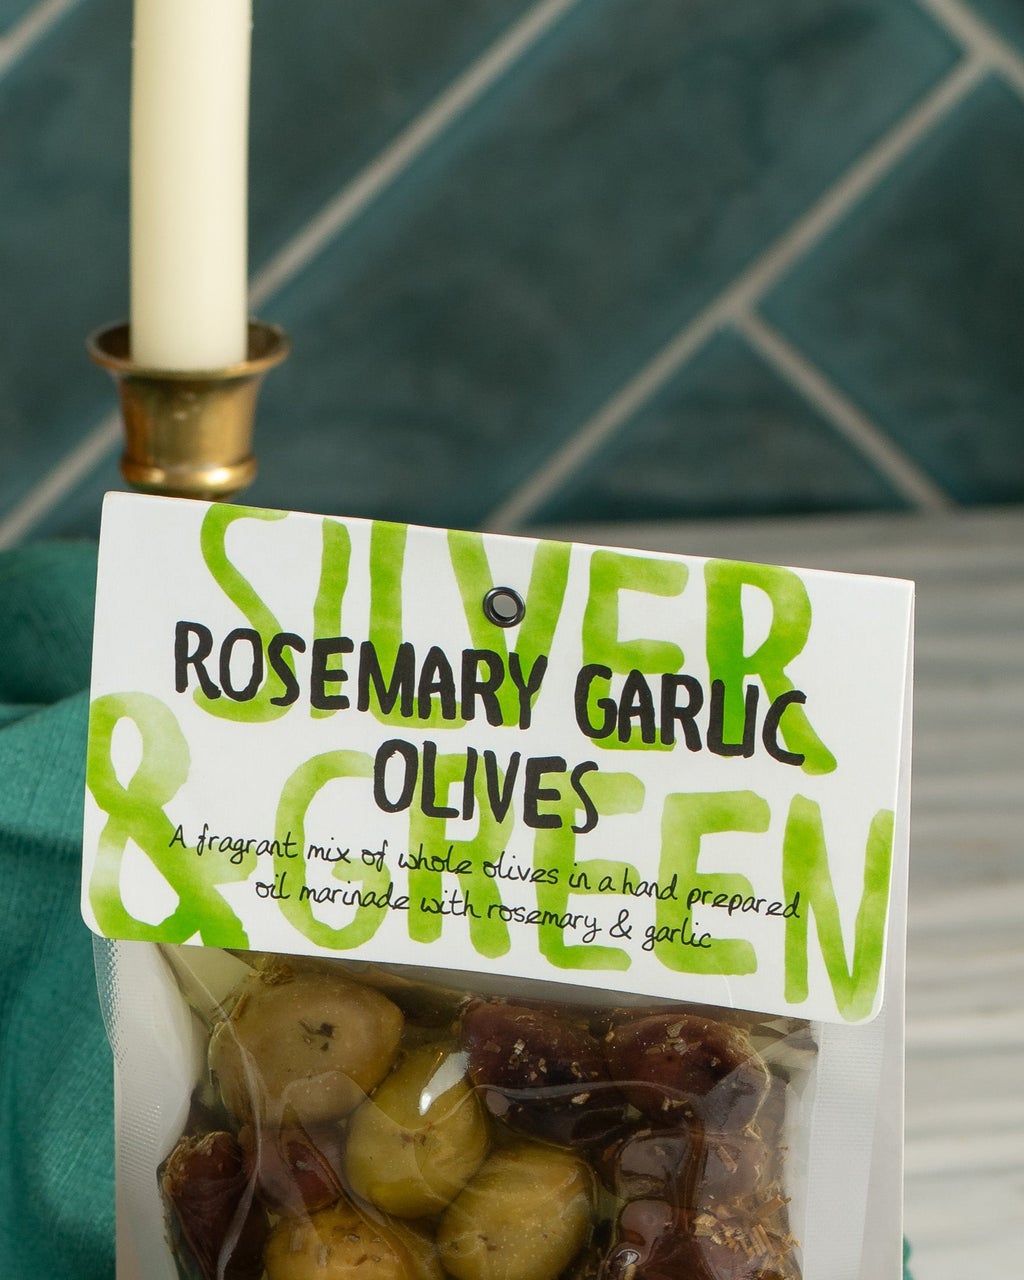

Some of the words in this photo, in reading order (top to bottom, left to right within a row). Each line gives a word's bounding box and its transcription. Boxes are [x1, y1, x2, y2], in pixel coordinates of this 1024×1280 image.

[175, 620, 548, 730] ROSEMARY
[575, 662, 807, 767] GARLIC
[193, 503, 837, 775] SILVER
[374, 738, 599, 833] OLIVES
[169, 823, 186, 848] A
[196, 823, 298, 864] fragrant
[307, 837, 352, 863] mix
[361, 840, 388, 872] of
[398, 843, 473, 874] whole
[483, 851, 559, 885] olives
[569, 863, 591, 889] in
[598, 873, 616, 892] a
[622, 867, 678, 901] hand
[686, 887, 800, 918] prepared
[255, 873, 290, 900] oil
[299, 880, 411, 910] marinade
[420, 889, 482, 918] with
[487, 903, 602, 943] rosemary
[609, 909, 632, 939] &
[641, 917, 712, 951] garlic
[275, 748, 894, 1022] GREEN
